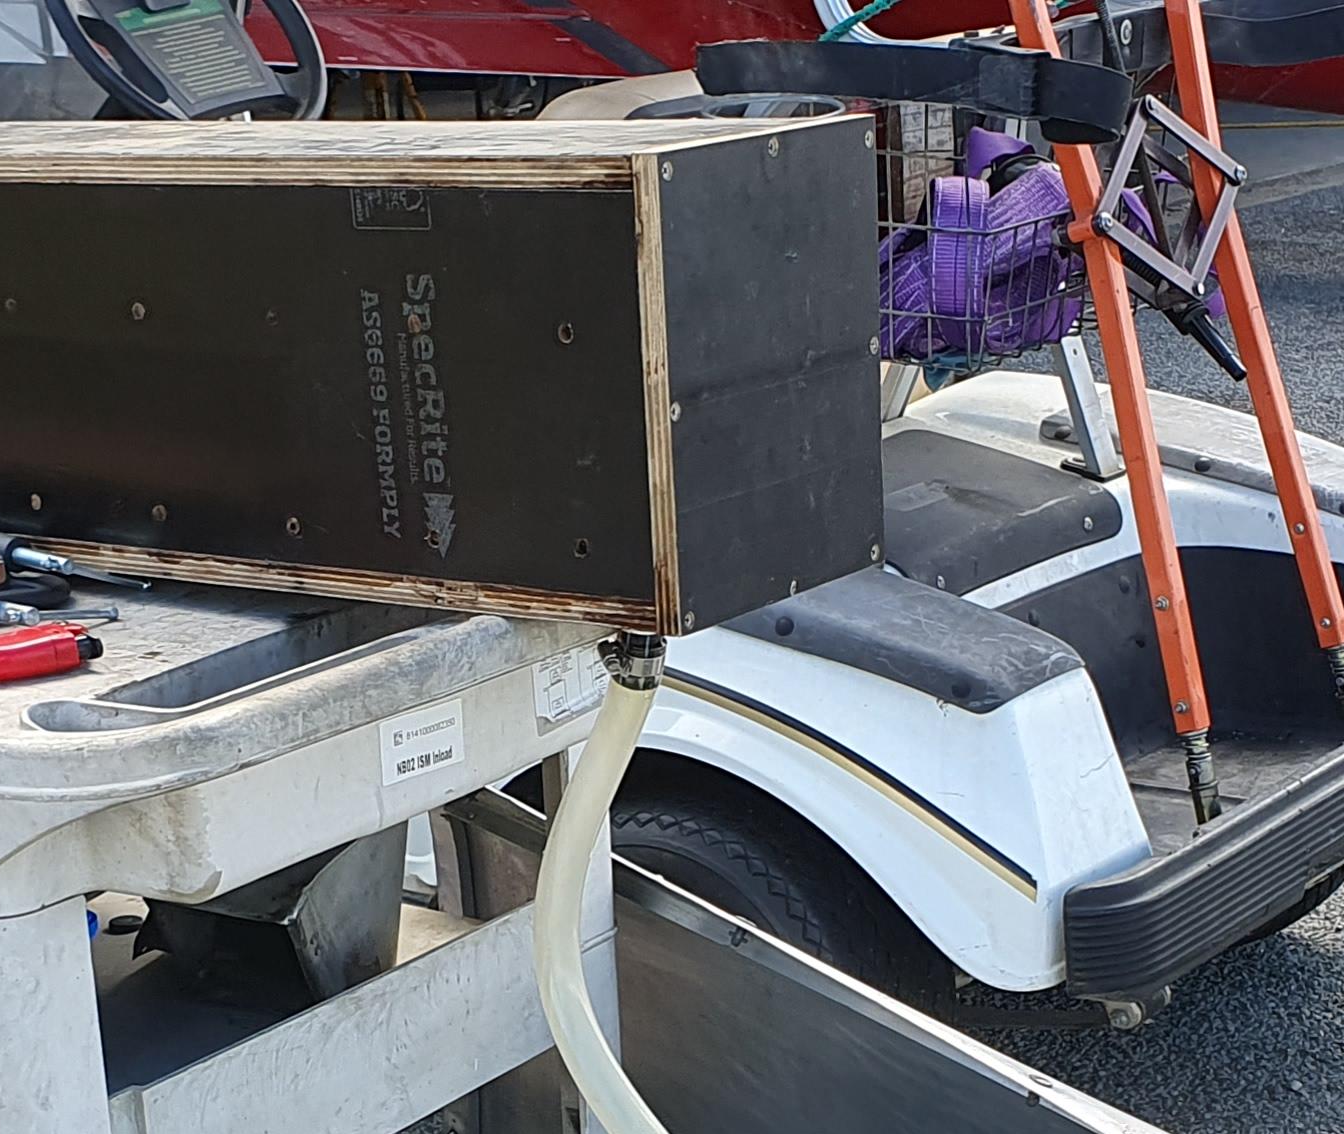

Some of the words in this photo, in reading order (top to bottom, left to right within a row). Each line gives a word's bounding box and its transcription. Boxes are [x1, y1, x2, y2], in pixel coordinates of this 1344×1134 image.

[403, 274, 447, 483] SpecRite
[404, 417, 415, 438] For
[373, 408, 401, 538] FORMPLY
